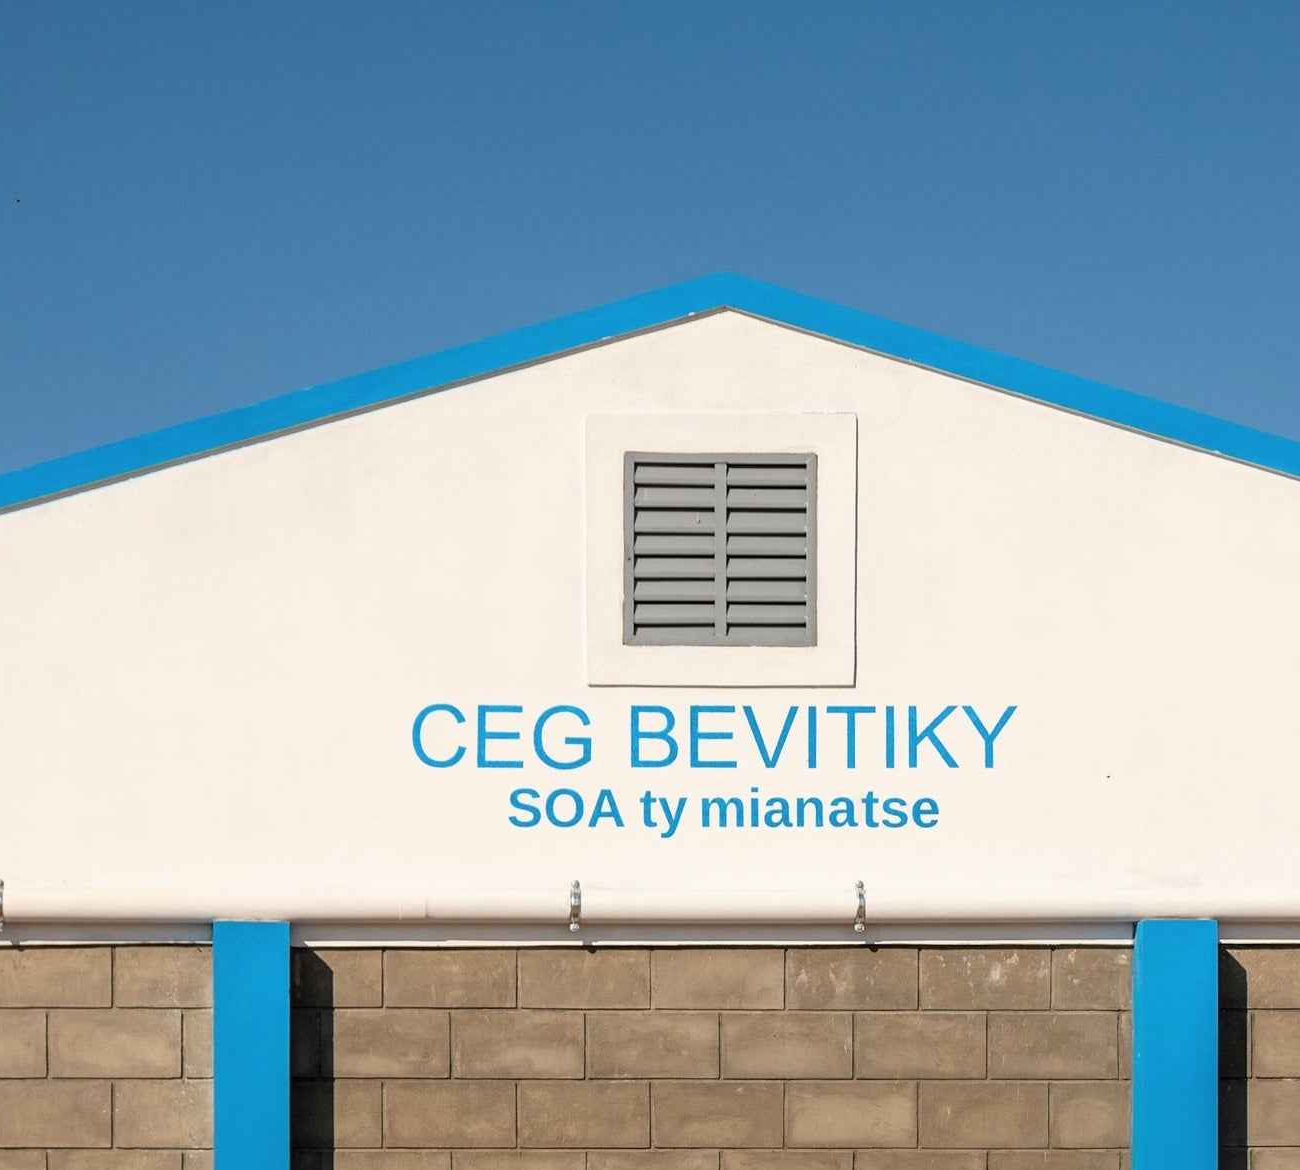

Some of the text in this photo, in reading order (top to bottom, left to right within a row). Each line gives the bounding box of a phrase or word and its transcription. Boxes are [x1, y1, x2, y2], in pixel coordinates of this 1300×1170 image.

[411, 702, 1019, 771] CEG BEVITIKY
[507, 786, 940, 840] SOA ty mianatse
